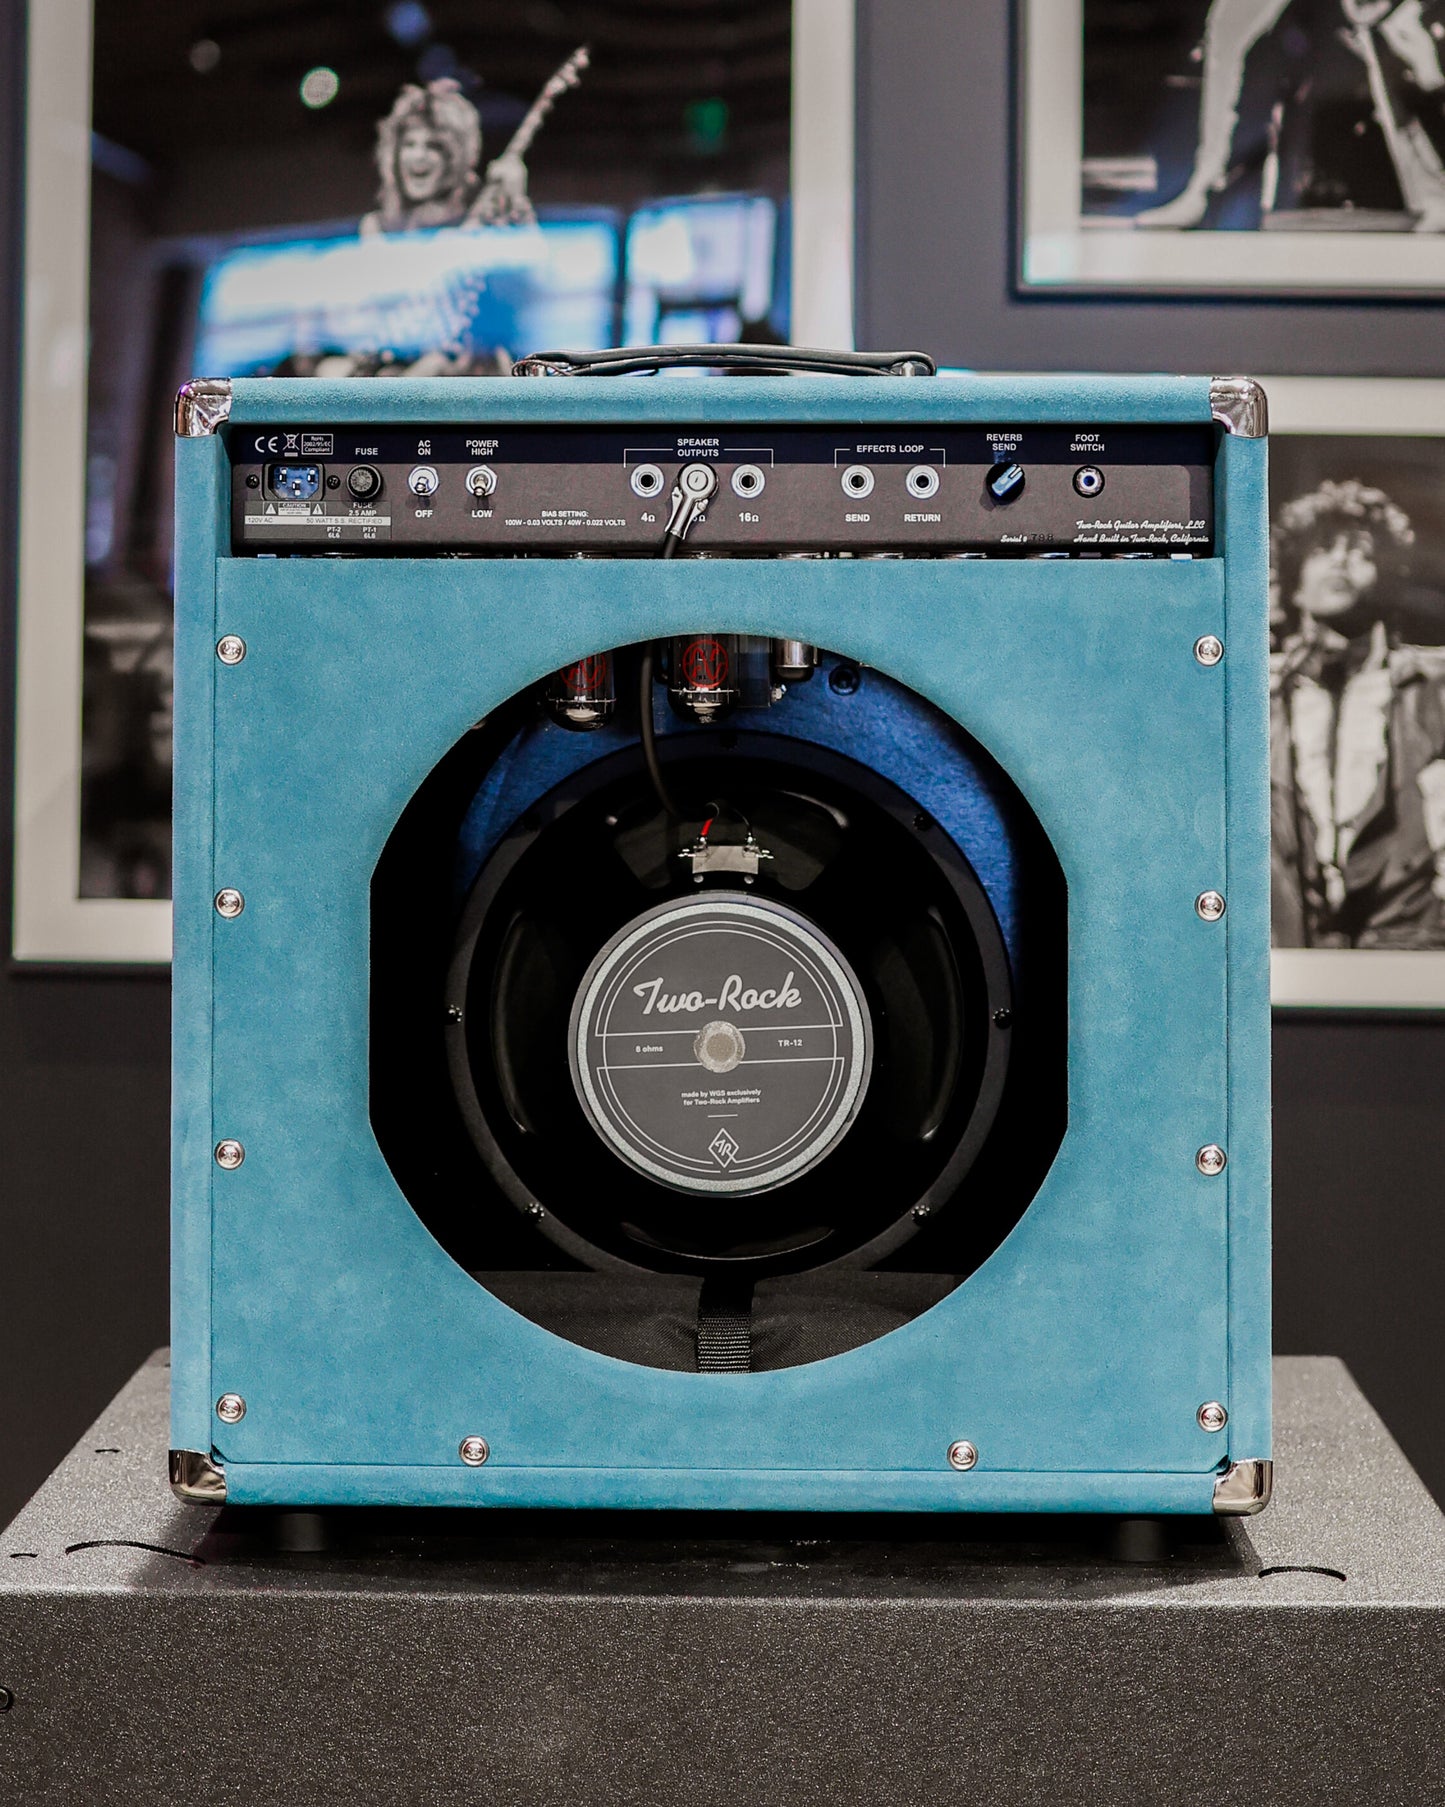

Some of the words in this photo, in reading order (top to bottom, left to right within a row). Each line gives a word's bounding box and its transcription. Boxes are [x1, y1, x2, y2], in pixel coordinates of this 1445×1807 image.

[986, 433, 1023, 442] REVERB
[1075, 434, 1100, 442] FOOT
[417, 440, 431, 448] AC
[465, 440, 499, 448] POWER
[677, 438, 719, 446] SPEAKER
[856, 445, 896, 453] EFFECTS
[899, 445, 924, 453] LOOP
[992, 443, 1016, 451] SEND
[1070, 443, 1105, 451] SWITCH
[355, 447, 379, 456] FUSE
[417, 448, 431, 456] ON
[471, 448, 494, 456] HIGH
[677, 449, 719, 457] OUTPUTS
[415, 510, 433, 518] OFF
[472, 510, 493, 518] LOW
[845, 514, 870, 522] SEND
[904, 514, 941, 522] RETURN
[1075, 520, 1113, 530] Two-Rock
[1114, 520, 1140, 531] Guitar
[1185, 520, 1206, 529] LLC
[1000, 534, 1022, 543] Serial
[1073, 534, 1099, 544] Hand
[1099, 534, 1120, 543] Built
[1120, 535, 1130, 543] in
[1170, 534, 1210, 545] California
[633, 971, 802, 1014] Two-Rock
[778, 1039, 803, 1047] TR-12
[635, 1045, 641, 1053] 8
[642, 1045, 664, 1053] ohms
